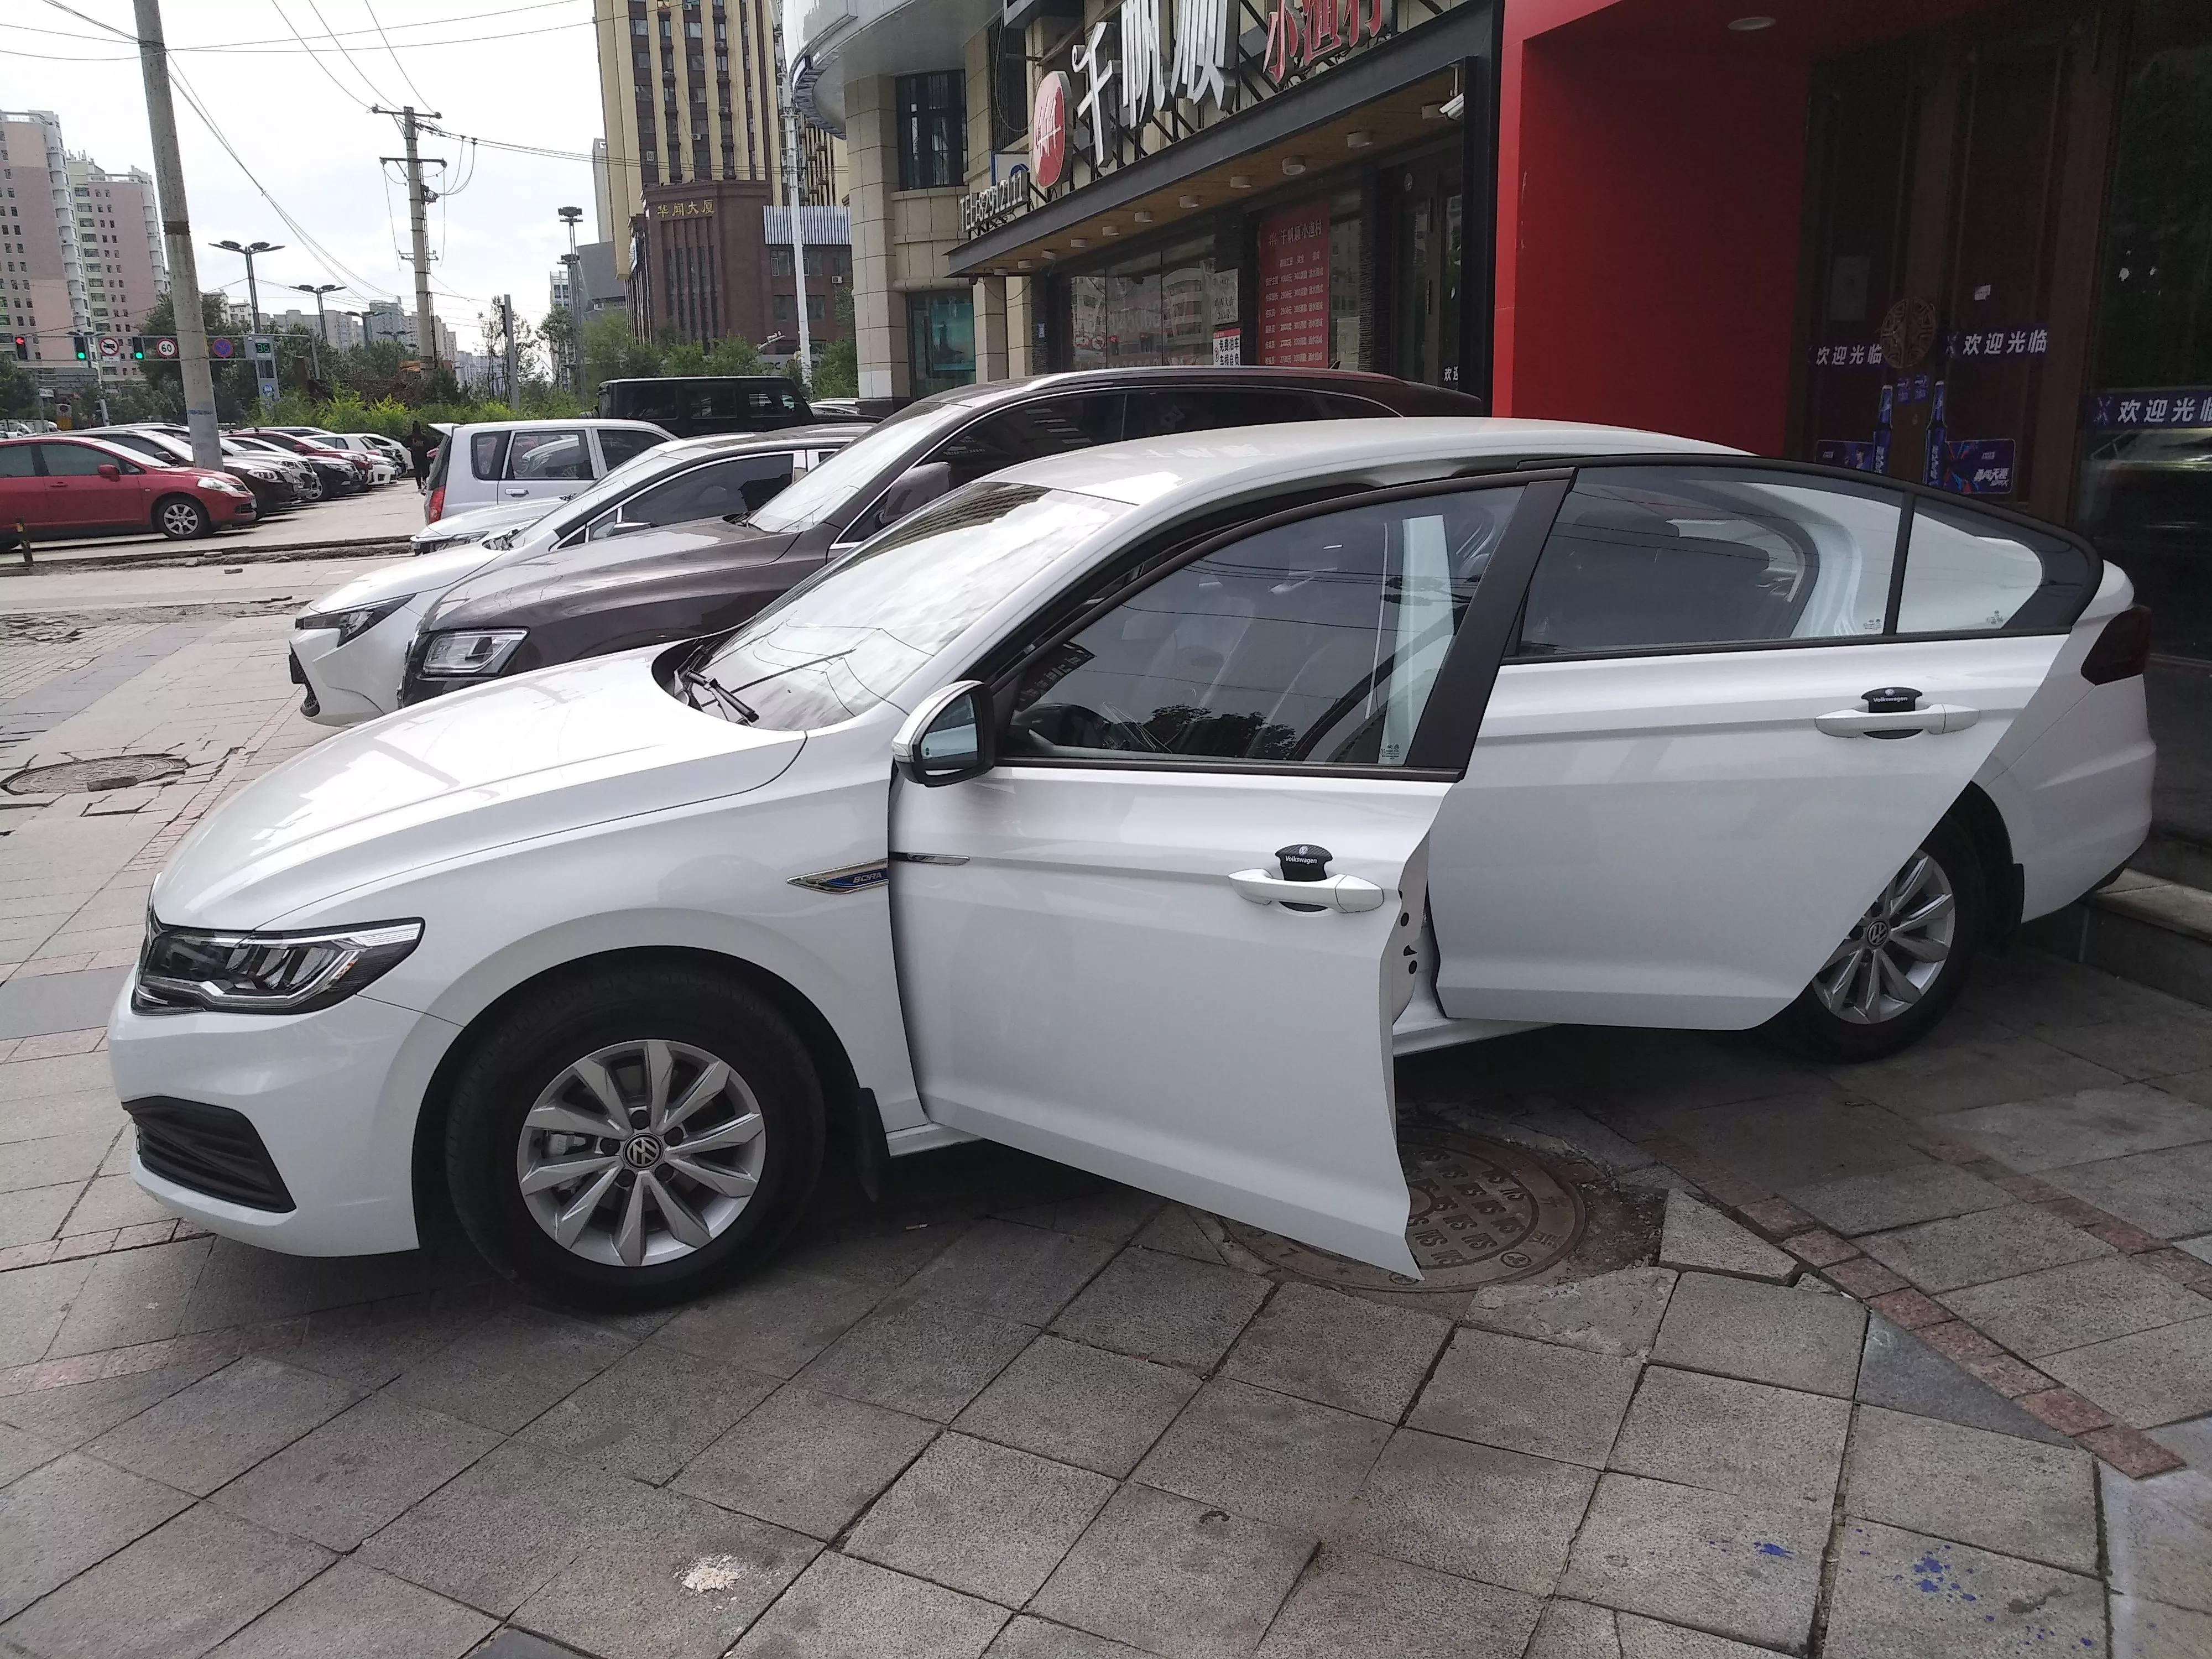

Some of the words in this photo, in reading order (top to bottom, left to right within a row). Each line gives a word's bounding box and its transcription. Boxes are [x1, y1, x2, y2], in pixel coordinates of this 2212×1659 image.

[657, 200, 714, 217] 华闻大厦
[161, 343, 172, 352] 60
[257, 343, 269, 352] 36
[1963, 329, 2048, 356] 欢迎光临
[1285, 855, 1317, 864] Volkswagen
[853, 872, 882, 883] BORA
